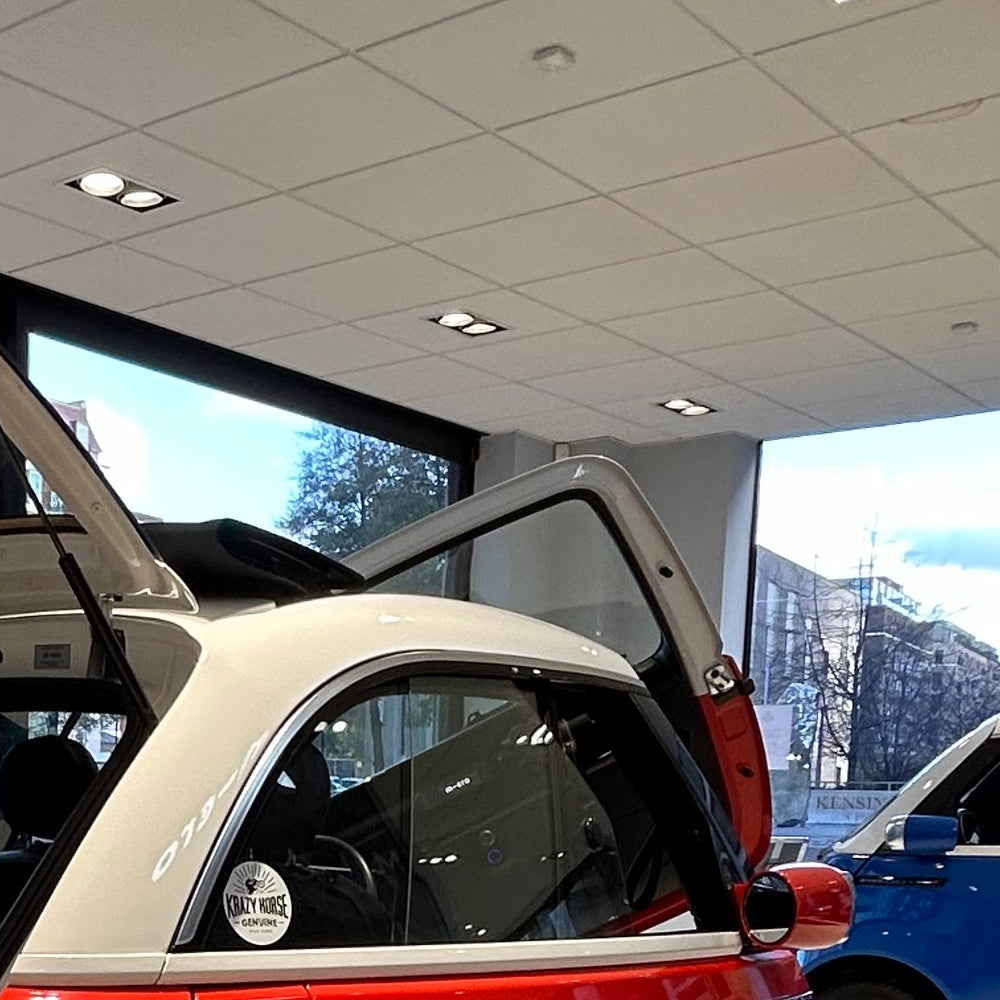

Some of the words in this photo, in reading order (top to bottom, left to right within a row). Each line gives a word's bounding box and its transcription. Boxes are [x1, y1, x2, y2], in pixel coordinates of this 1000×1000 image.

[226, 893, 257, 918] KRAZY
[259, 893, 289, 919] HORSE
[241, 918, 278, 927] GENUINE
